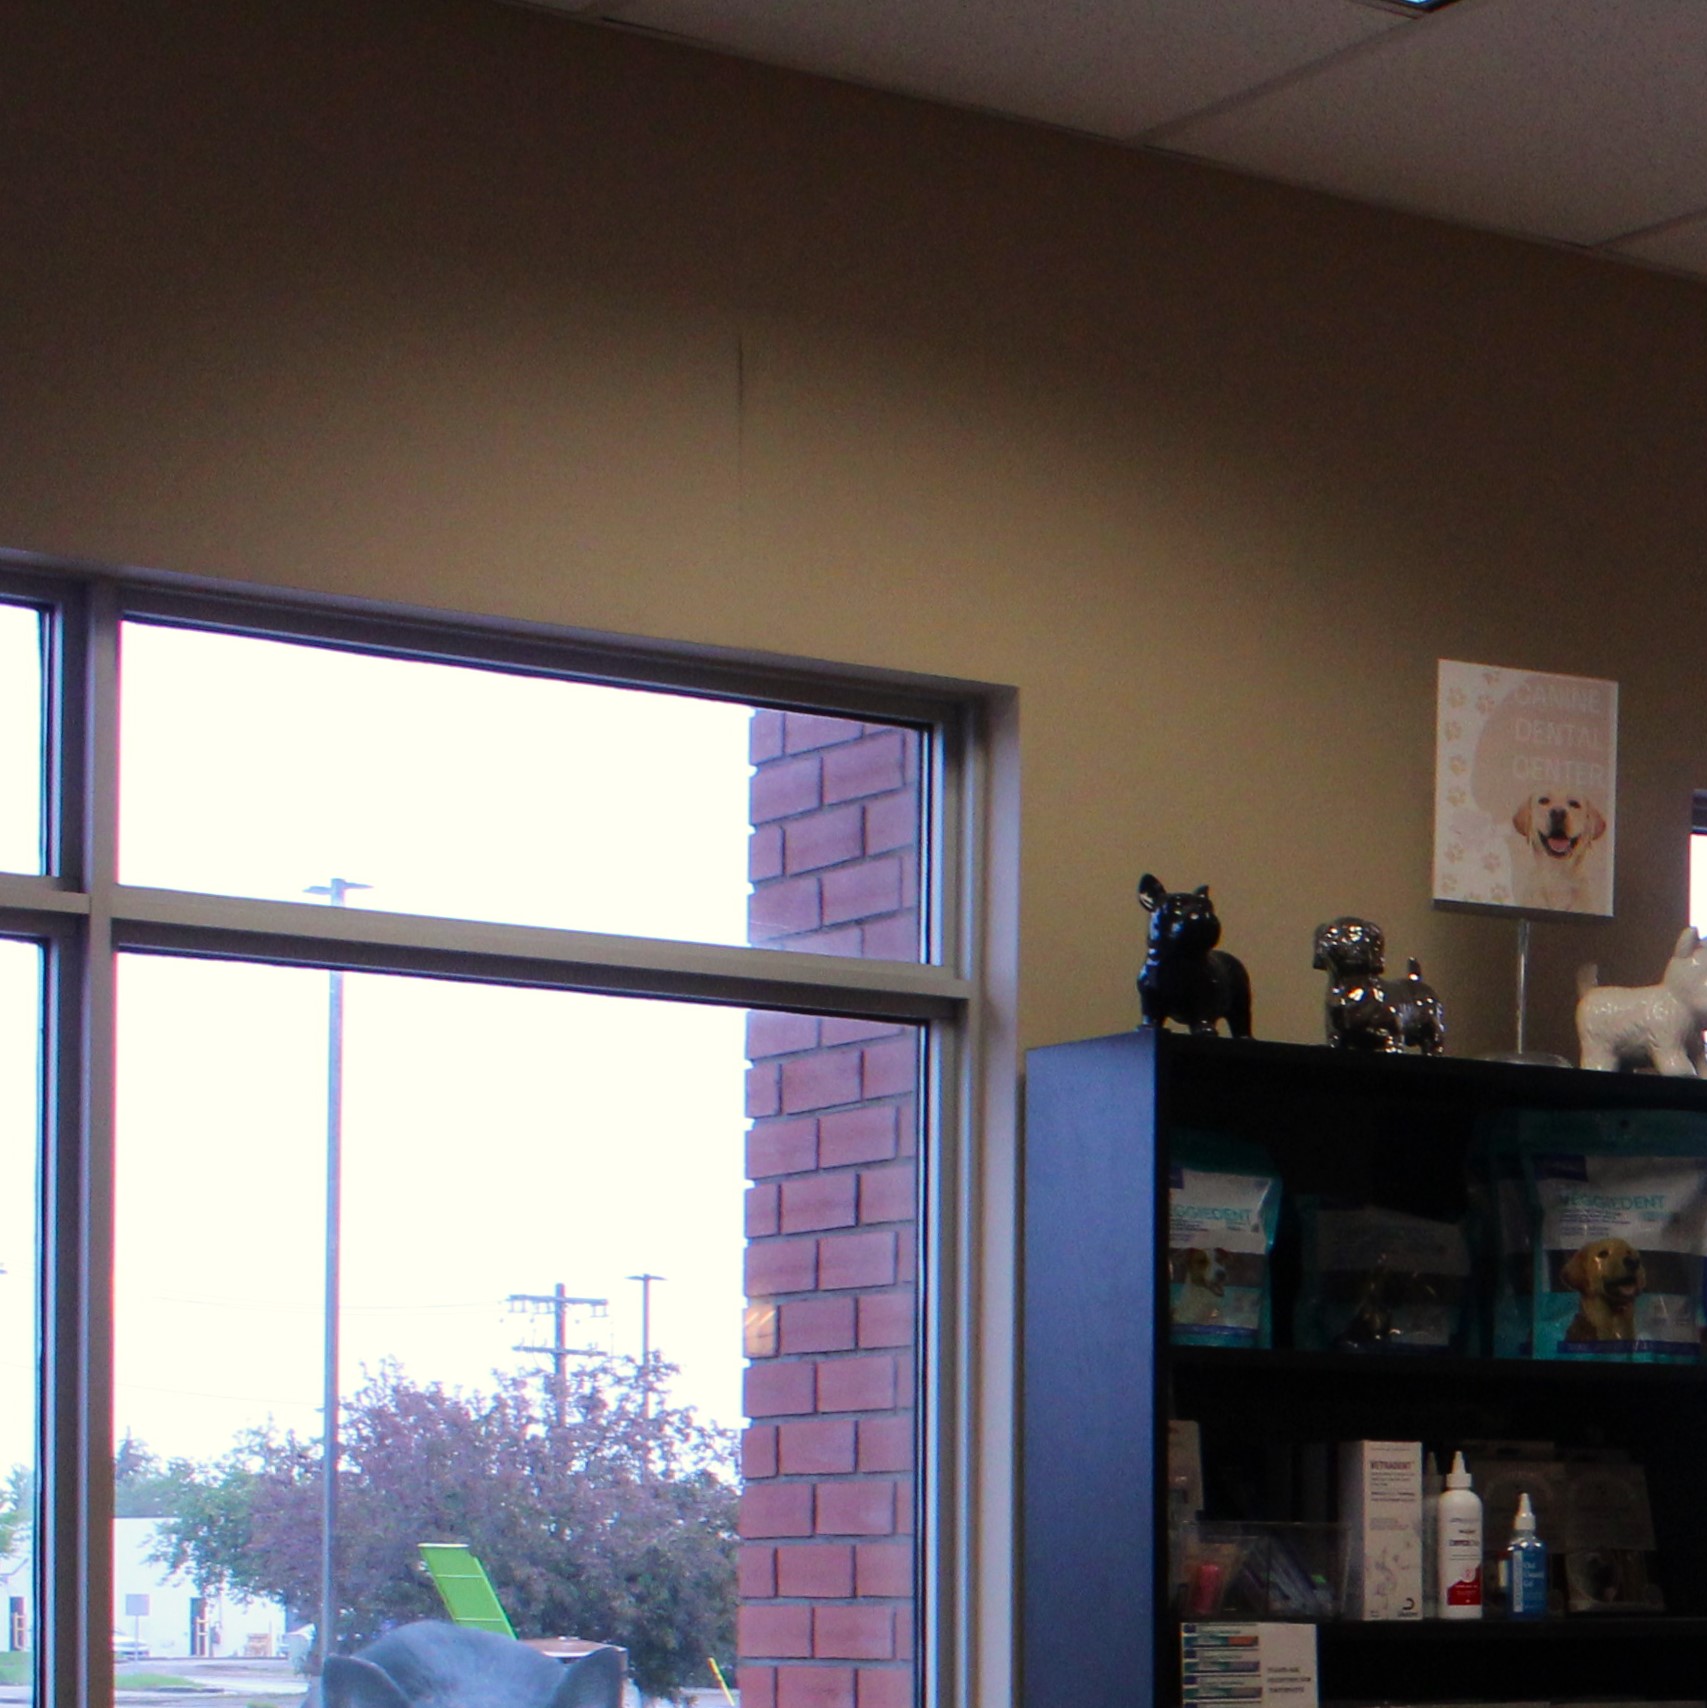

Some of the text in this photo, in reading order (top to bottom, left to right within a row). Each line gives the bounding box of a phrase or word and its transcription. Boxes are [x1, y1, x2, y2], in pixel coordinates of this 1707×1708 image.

[1515, 681, 1602, 713] CANINE
[1514, 717, 1602, 750] DENTAL
[1512, 755, 1605, 786] CENTER
